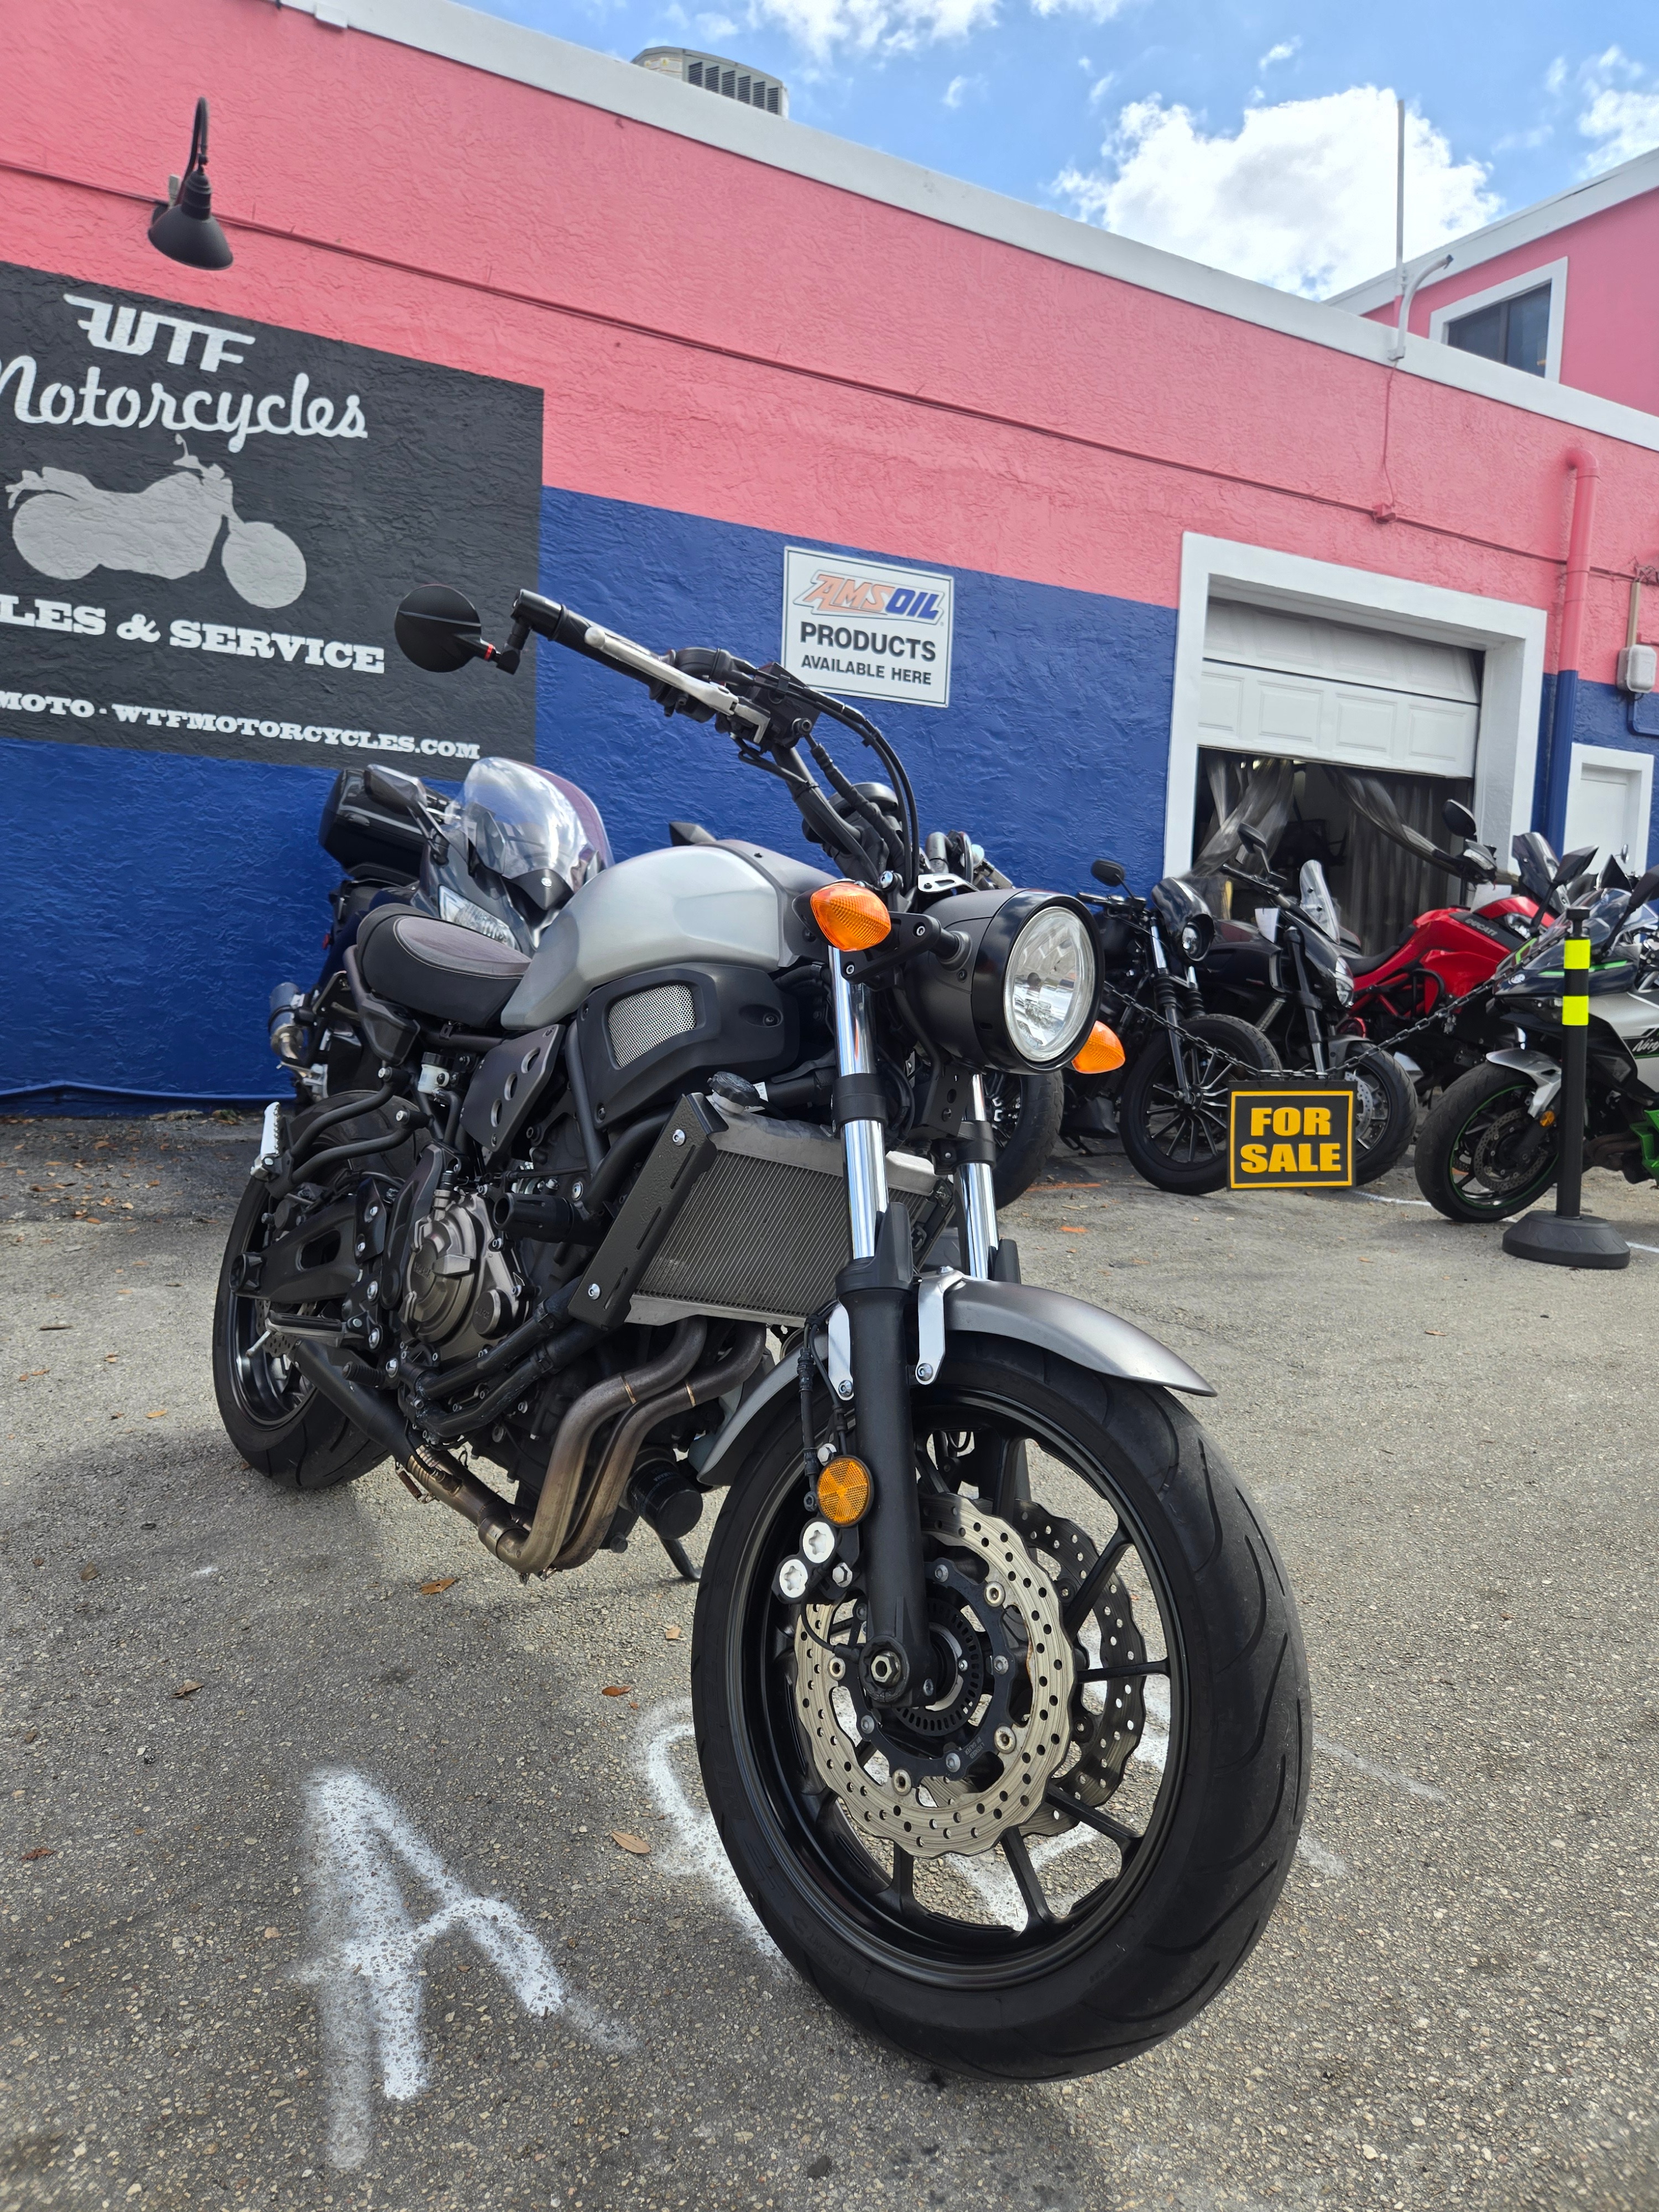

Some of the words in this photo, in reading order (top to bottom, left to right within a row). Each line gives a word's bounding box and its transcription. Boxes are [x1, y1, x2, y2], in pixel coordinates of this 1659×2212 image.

[63, 293, 255, 372] WTF
[802, 573, 940, 620] AMSOIL
[116, 613, 161, 643] &
[170, 620, 385, 674] SERVICE
[800, 621, 936, 662] PRODUCTS
[801, 655, 885, 679] AVAILABLE
[891, 667, 932, 686] HERE
[111, 703, 480, 760] WTFMOTORCYCLES.COM
[1465, 918, 1498, 936] DUCATI
[1251, 1107, 1331, 1136] FOR
[1240, 1142, 1342, 1173] SALE
